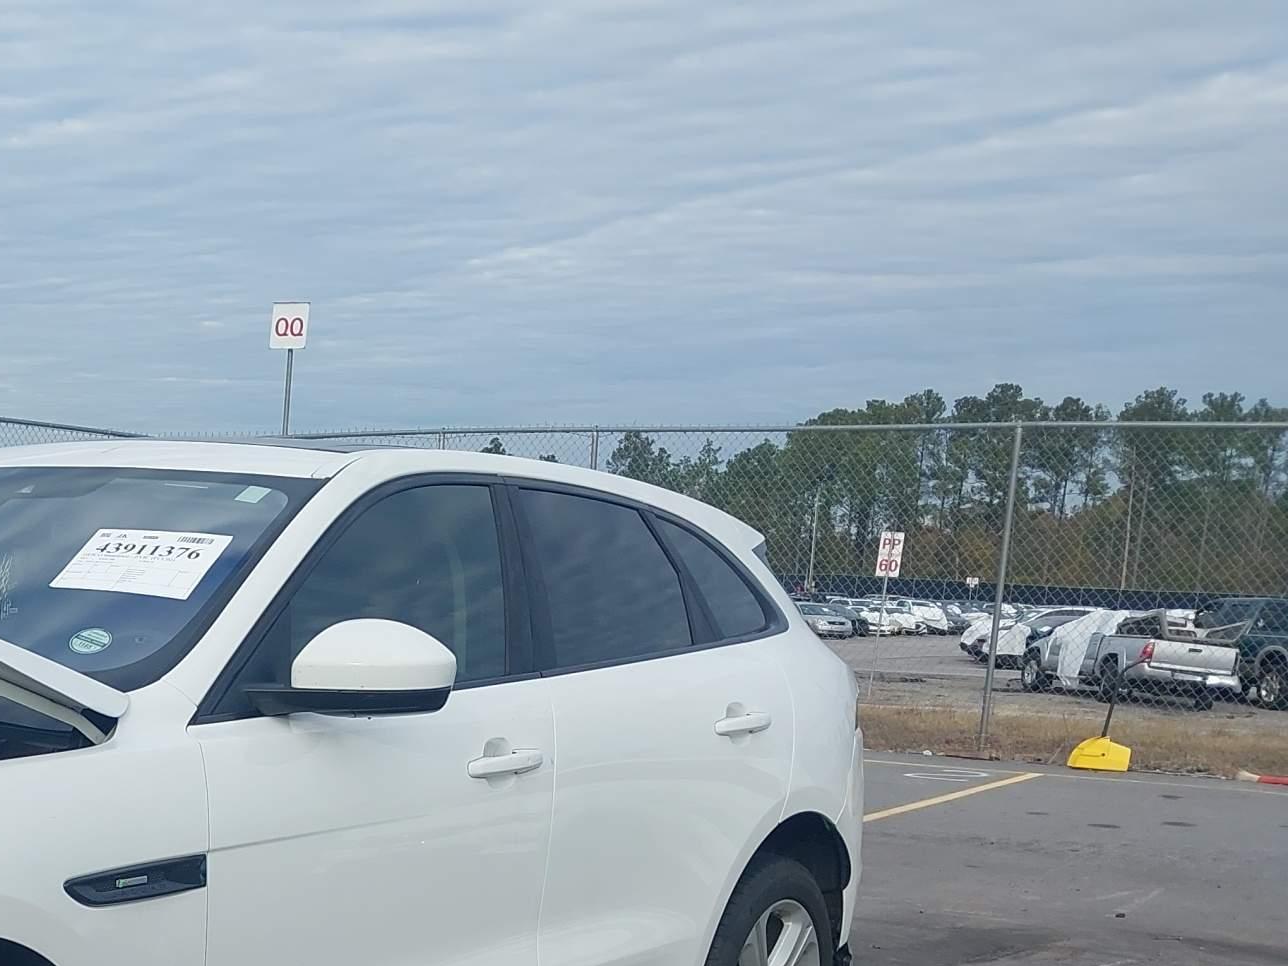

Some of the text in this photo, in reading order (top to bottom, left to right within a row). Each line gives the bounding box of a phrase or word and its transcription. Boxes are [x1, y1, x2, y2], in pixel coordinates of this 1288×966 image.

[275, 317, 304, 337] QQ
[95, 541, 205, 560] 43911376
[882, 537, 901, 550] PP
[878, 558, 899, 573] 60
